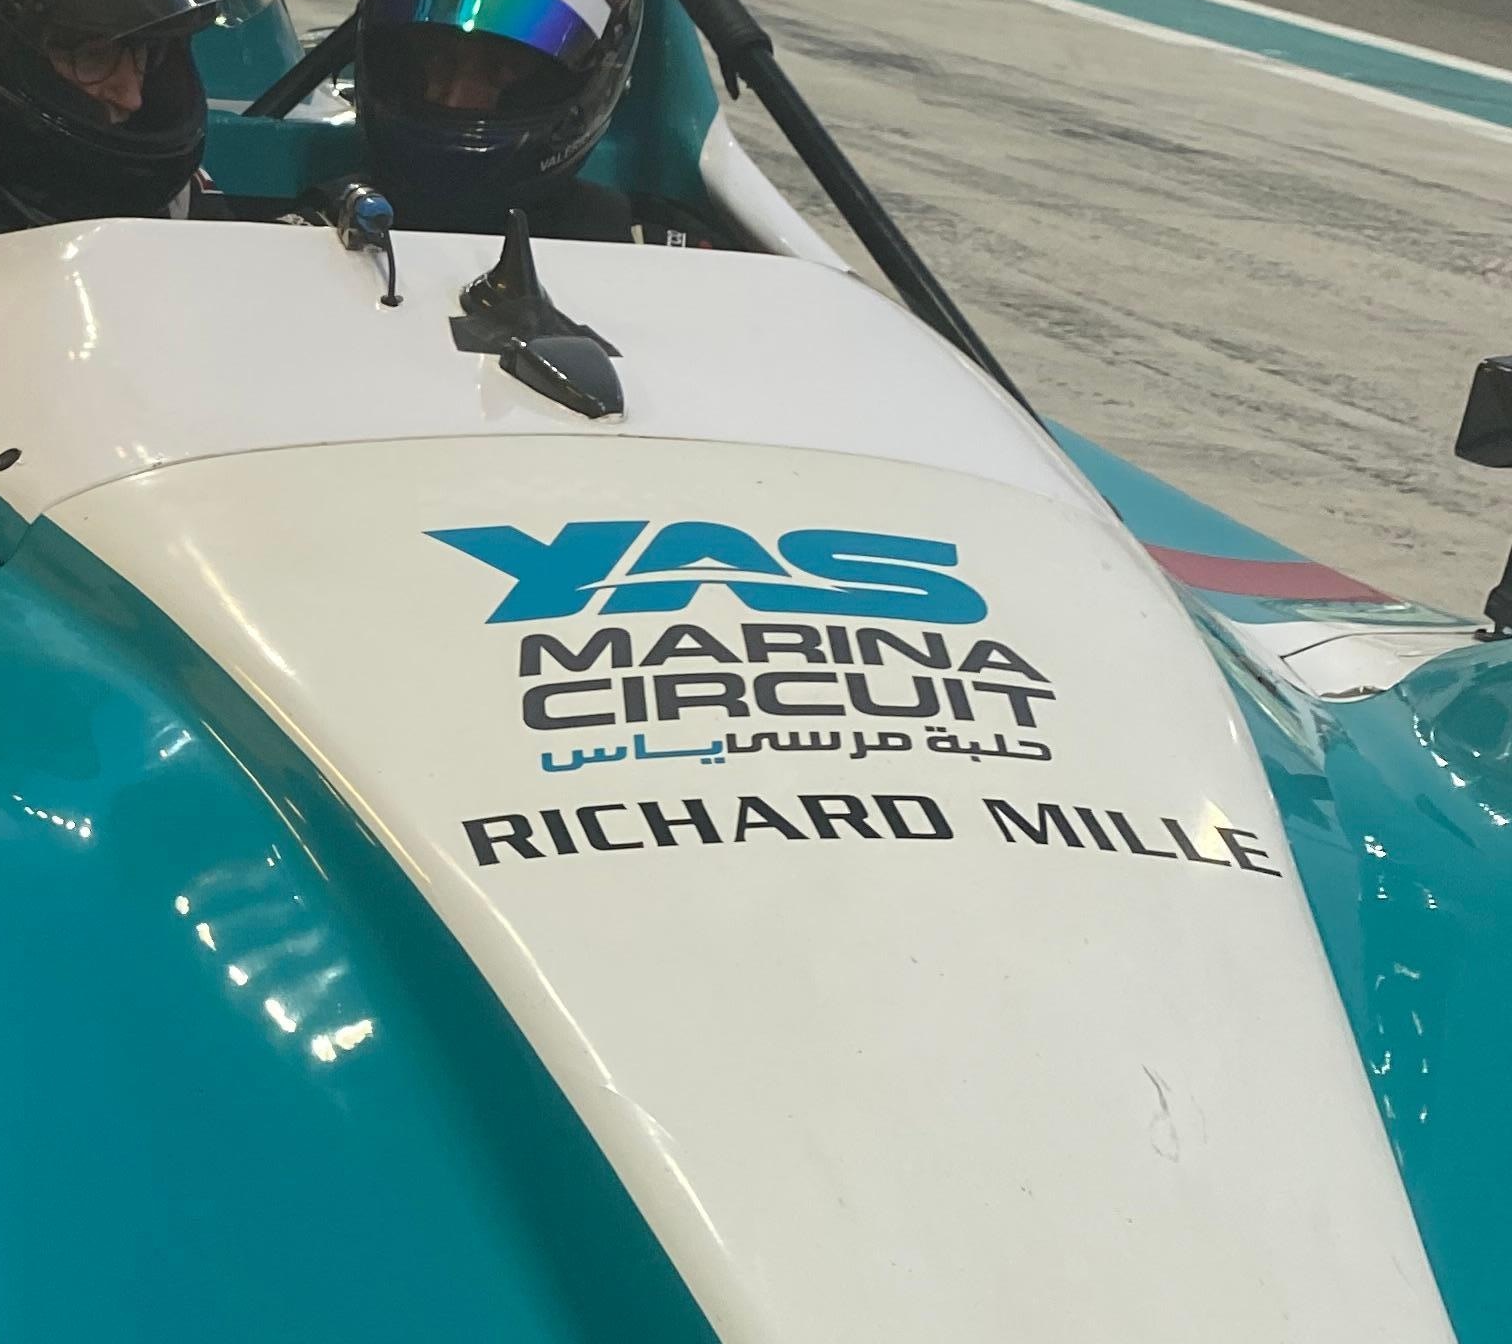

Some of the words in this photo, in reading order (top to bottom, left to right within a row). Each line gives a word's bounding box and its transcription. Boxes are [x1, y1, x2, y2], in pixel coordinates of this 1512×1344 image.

[421, 519, 989, 625] YAS
[518, 623, 1051, 683] MARINA
[521, 671, 1057, 731] CIRCUIT
[541, 733, 726, 772] ياس
[924, 725, 1053, 763] حلبة
[462, 794, 955, 867] RICHARD
[981, 798, 1284, 879] MILLE
